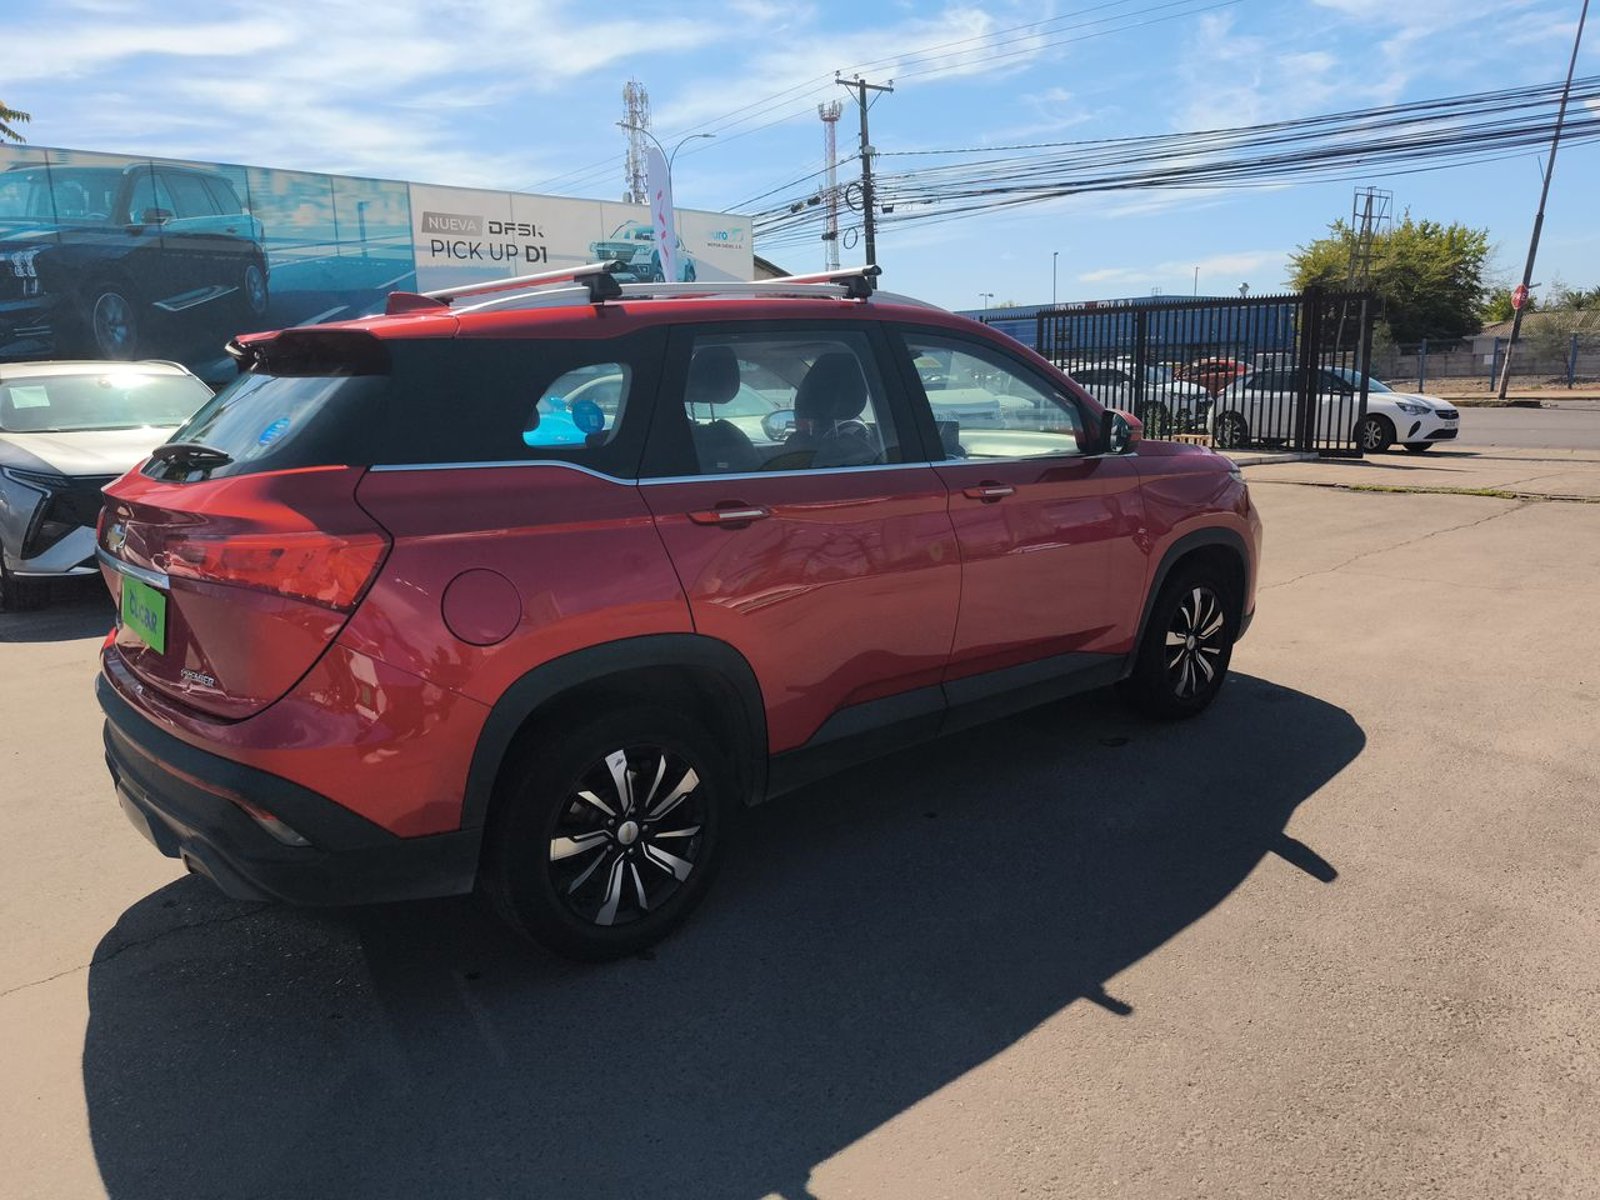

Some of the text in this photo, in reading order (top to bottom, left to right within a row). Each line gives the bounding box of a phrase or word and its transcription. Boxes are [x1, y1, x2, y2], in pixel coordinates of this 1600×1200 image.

[428, 216, 544, 238] NUEVA DFSK
[431, 239, 548, 264] PICK UP D1
